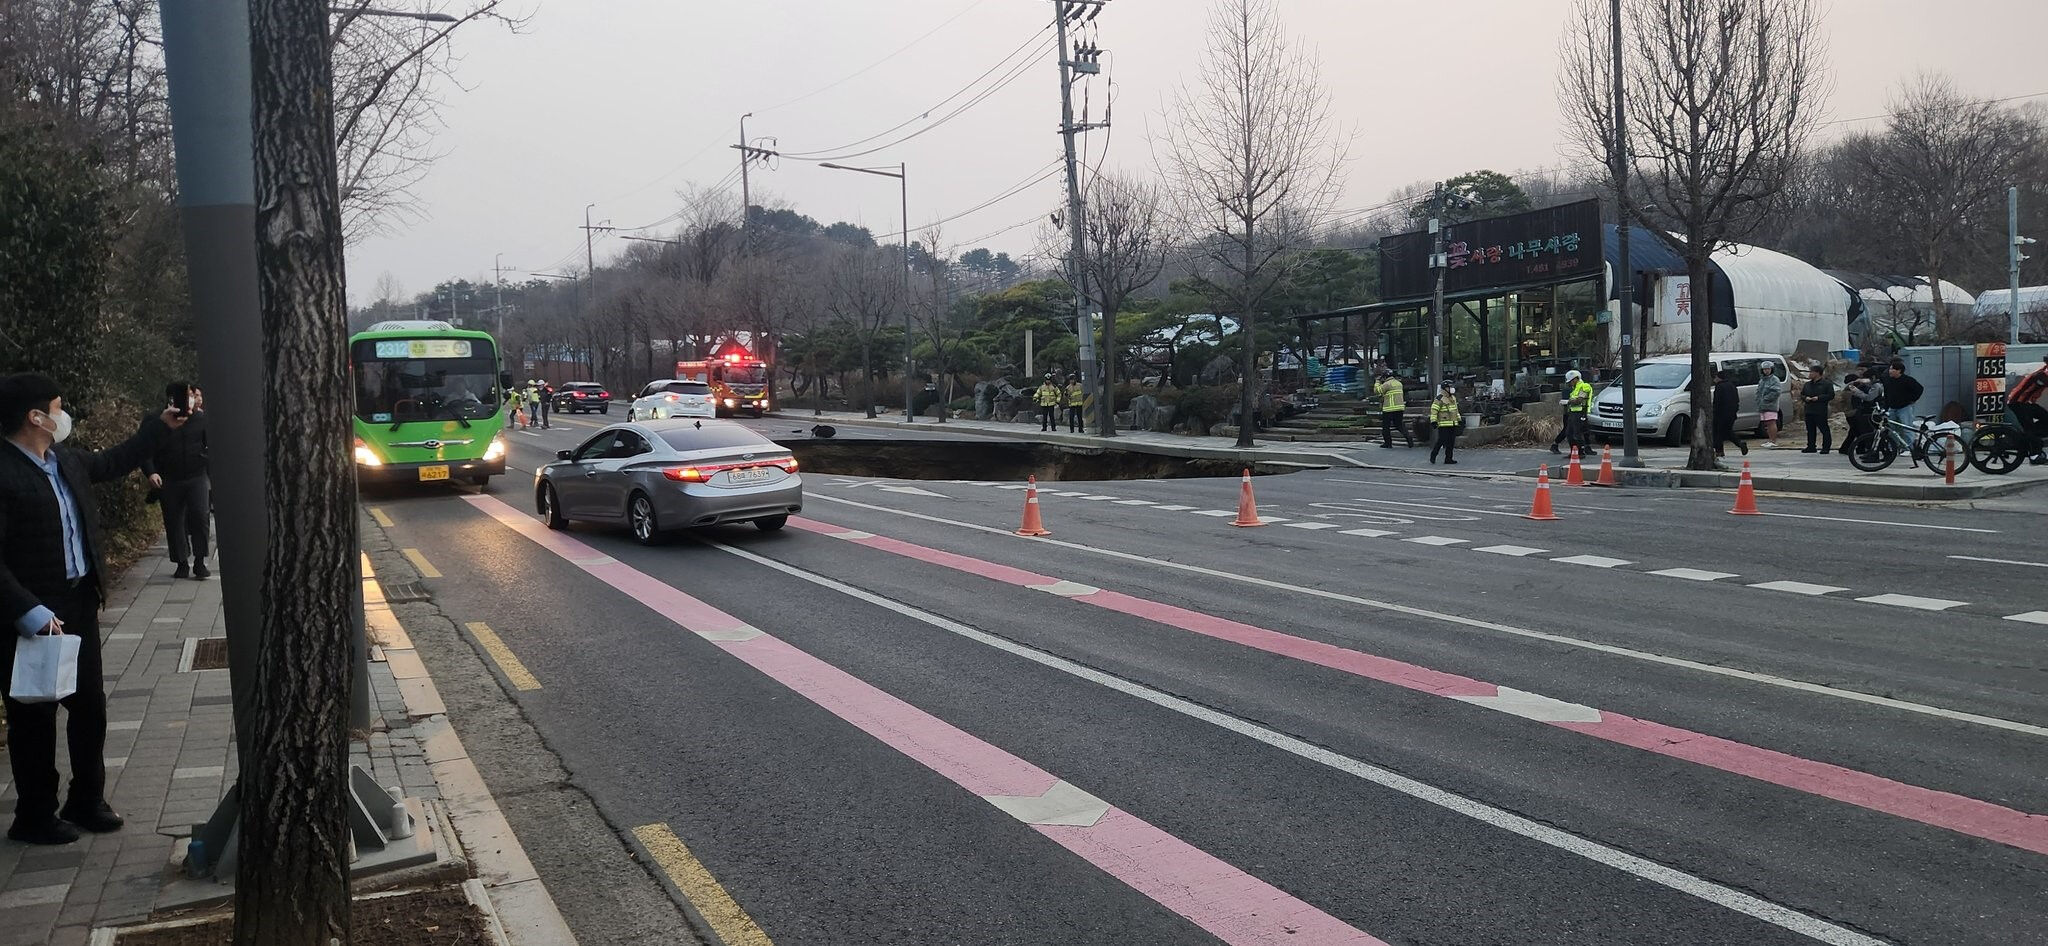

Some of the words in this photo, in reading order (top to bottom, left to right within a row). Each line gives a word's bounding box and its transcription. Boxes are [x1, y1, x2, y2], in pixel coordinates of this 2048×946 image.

[1508, 232, 1581, 260] 나무사랑
[1675, 282, 1691, 317] 꽃
[377, 342, 407, 356] 2312
[1977, 359, 2004, 375] 1655
[1977, 395, 2004, 412] 1535
[748, 470, 765, 478] 7639
